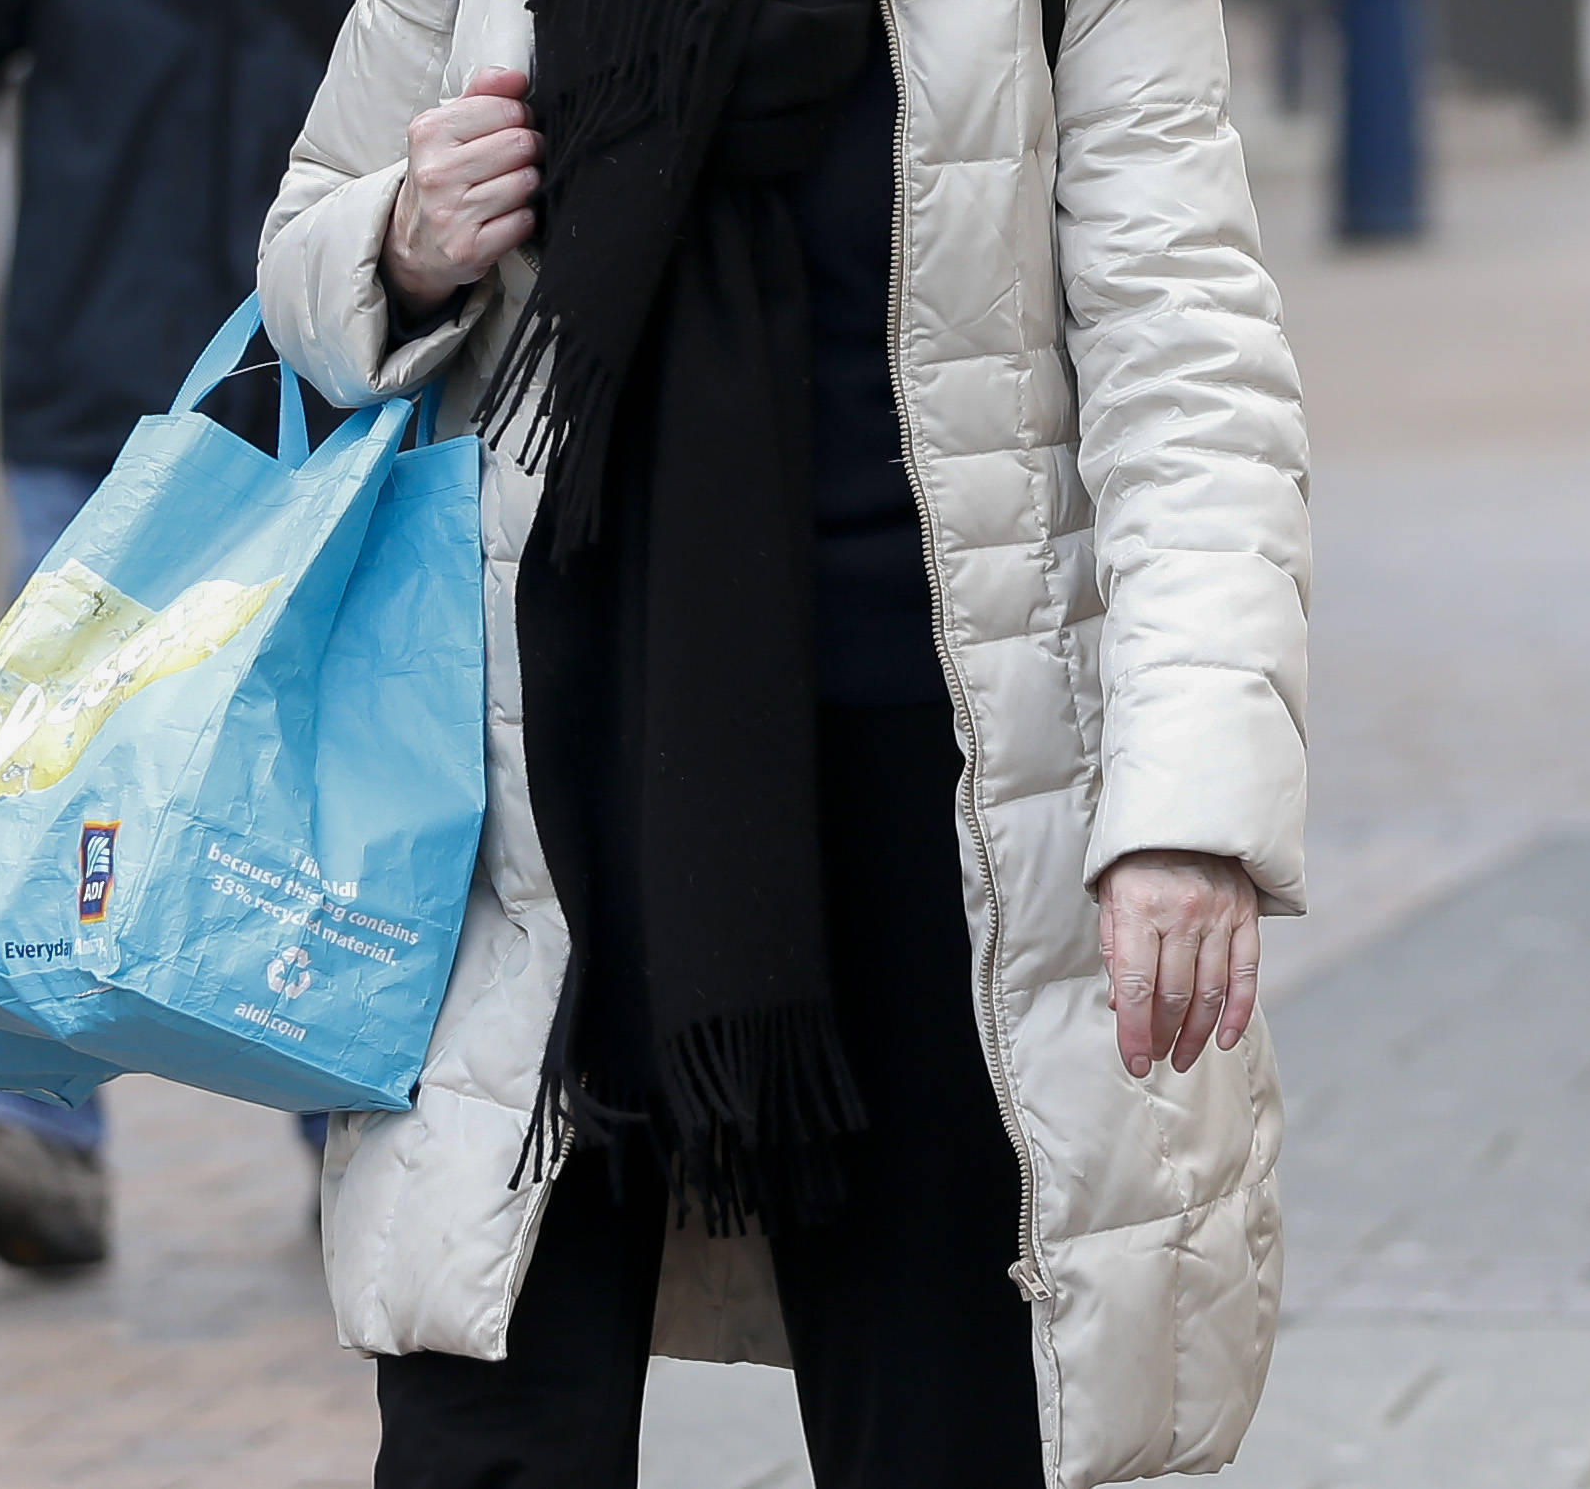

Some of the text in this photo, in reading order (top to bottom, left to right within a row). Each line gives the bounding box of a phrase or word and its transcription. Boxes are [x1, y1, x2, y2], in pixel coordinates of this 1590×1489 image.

[207, 843, 420, 947] because this ag contains
[211, 874, 253, 905] 33%
[321, 926, 398, 967] material.
[233, 1002, 307, 1042] aldi.com
